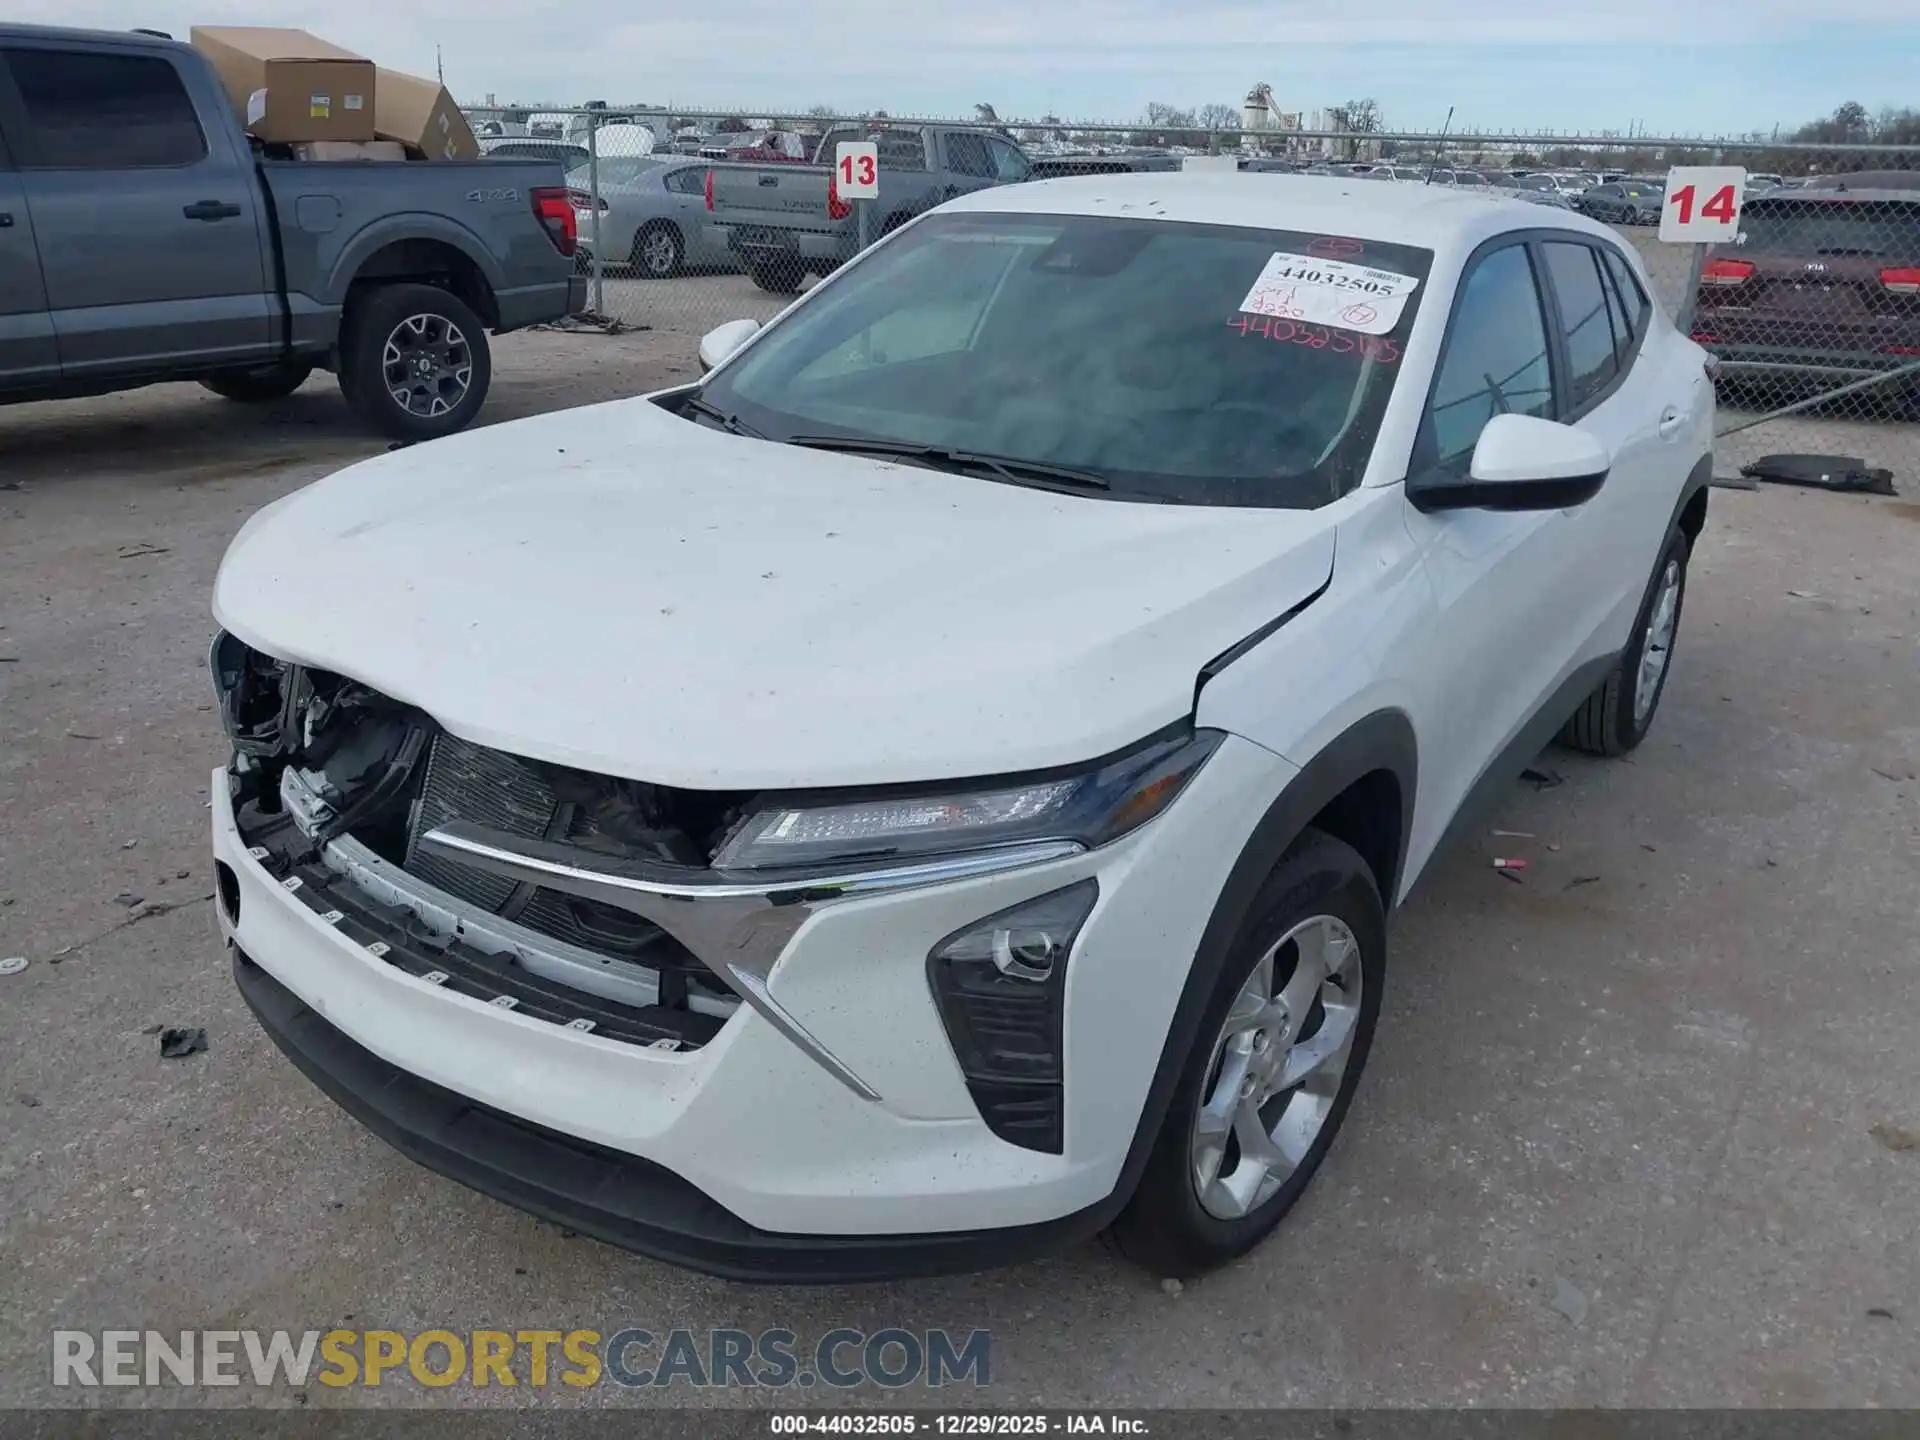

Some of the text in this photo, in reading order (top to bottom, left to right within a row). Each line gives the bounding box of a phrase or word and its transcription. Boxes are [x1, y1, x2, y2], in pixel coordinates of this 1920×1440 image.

[839, 155, 876, 186] 13
[1670, 184, 1737, 225] 14
[1278, 266, 1396, 296] 44032505
[1806, 262, 1824, 272] KIA
